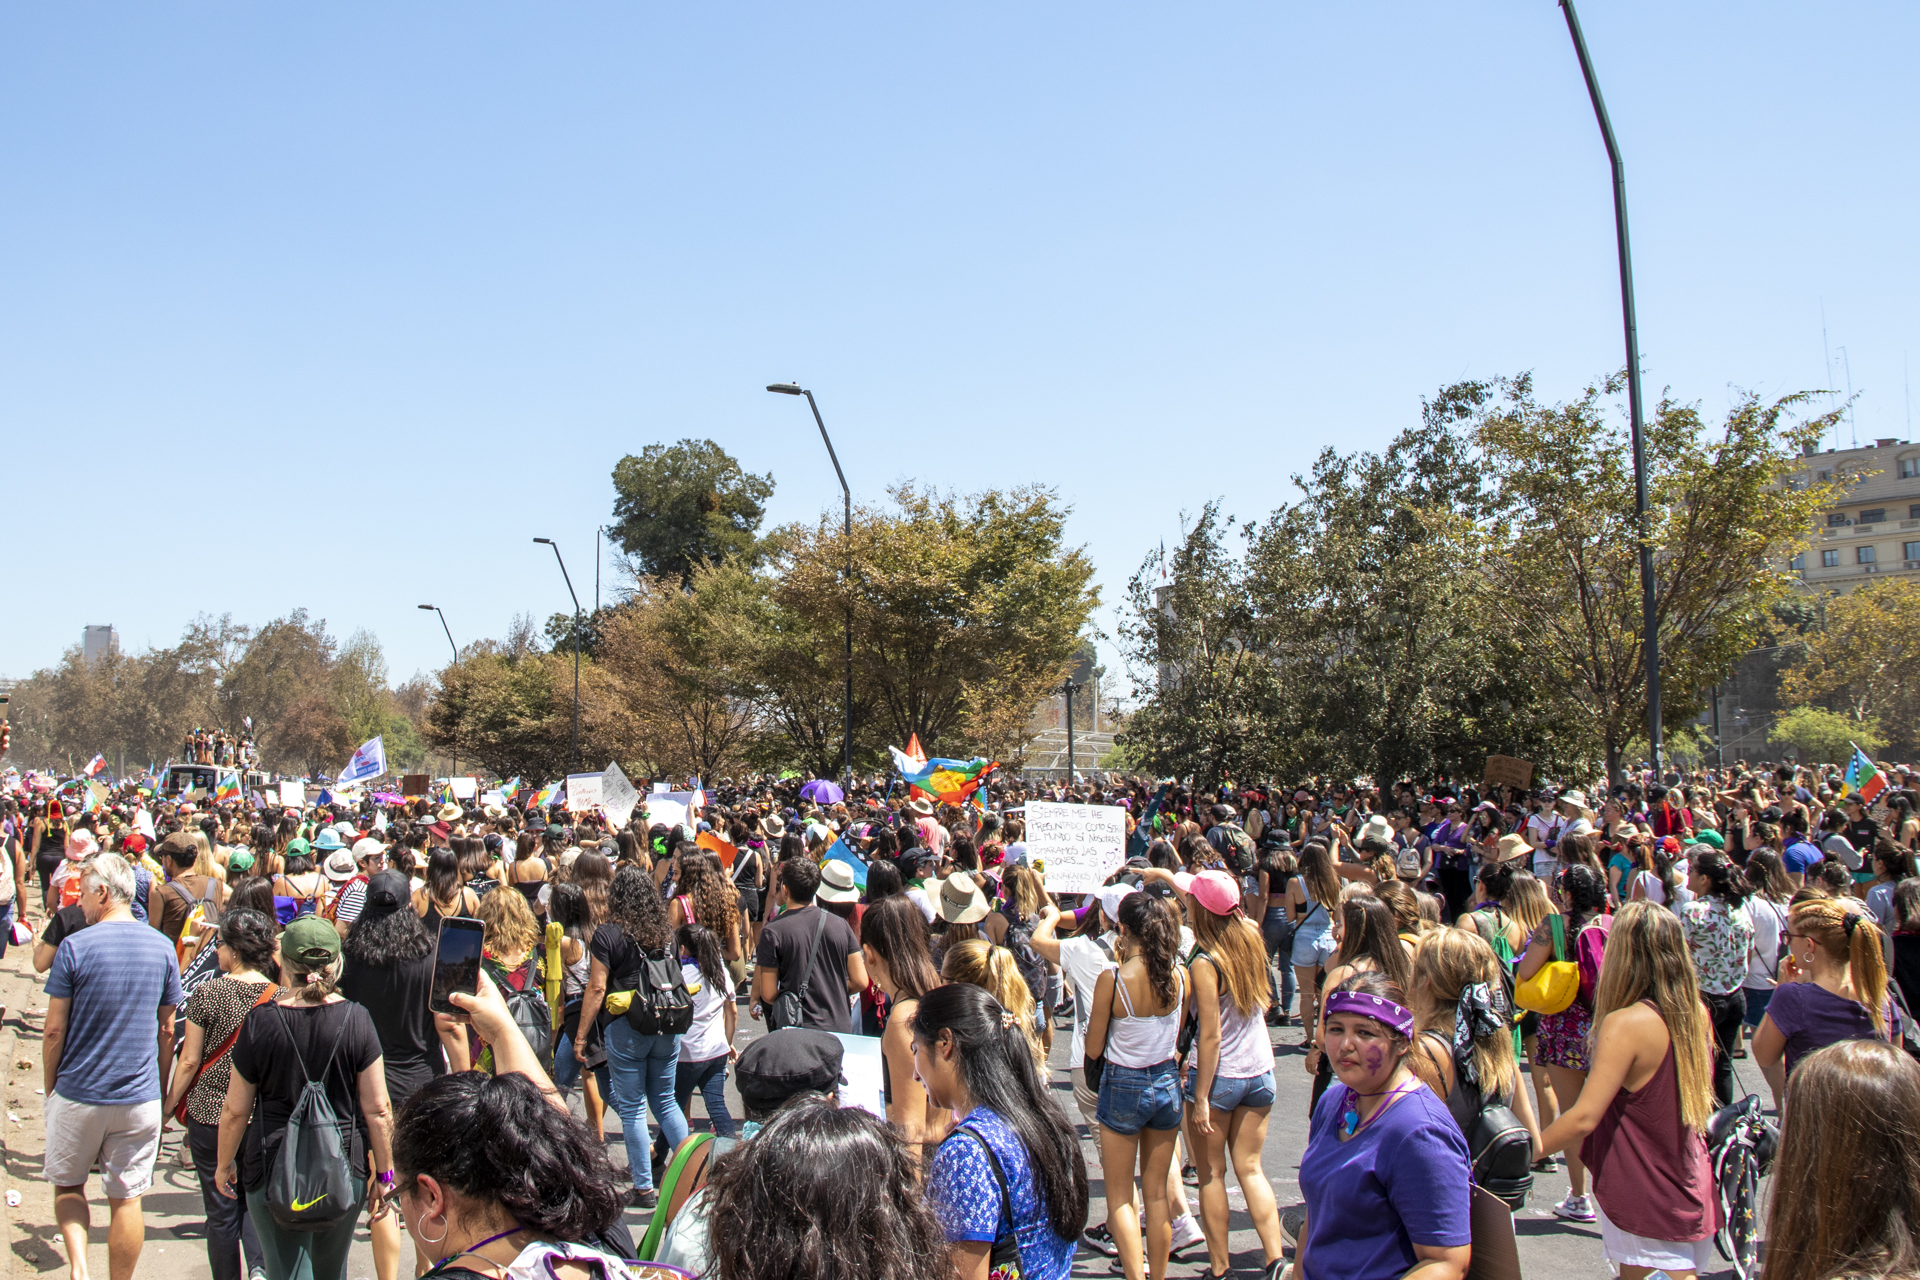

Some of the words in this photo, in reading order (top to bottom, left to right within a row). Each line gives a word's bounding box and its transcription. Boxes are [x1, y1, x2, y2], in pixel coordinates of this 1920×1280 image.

[1072, 808, 1087, 818] ME
[1091, 809, 1103, 819] HE
[1027, 819, 1082, 832] PREGUNTADO
[1085, 822, 1105, 832] COMO
[1029, 832, 1041, 842] EL
[1044, 832, 1071, 842] MUNDO
[1028, 844, 1078, 855] TOMARAMOS
[1081, 845, 1097, 856] LAS
